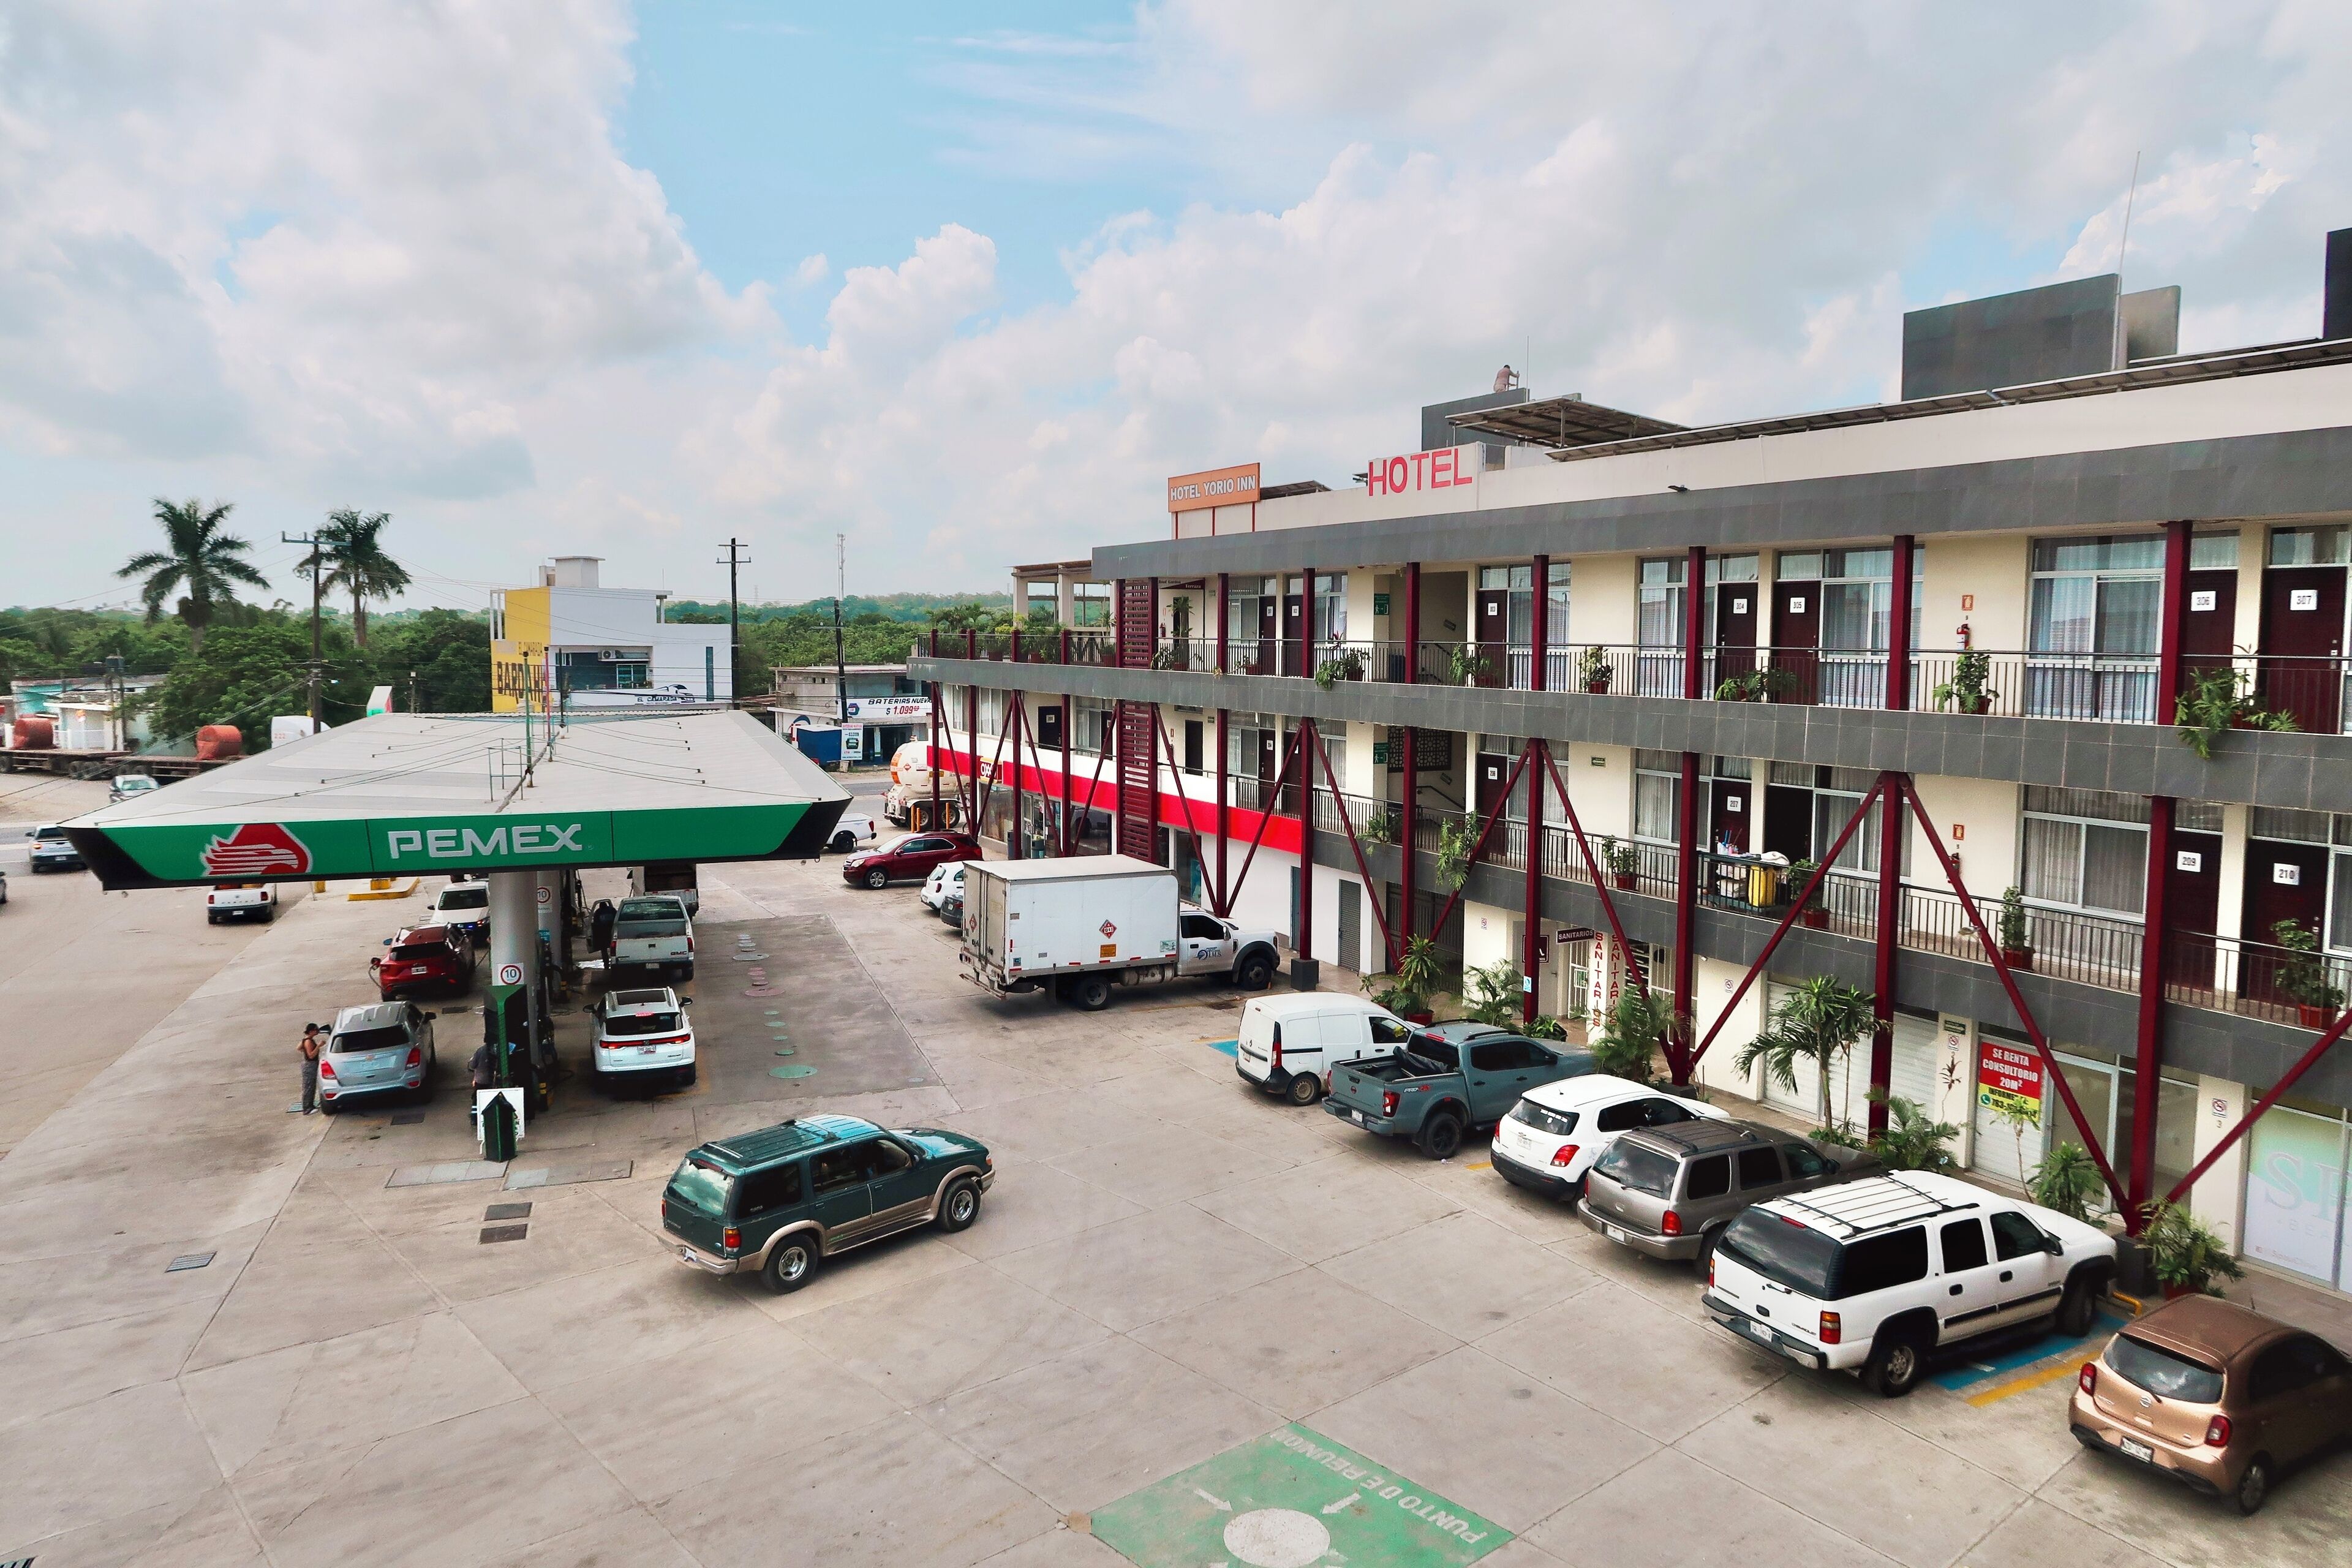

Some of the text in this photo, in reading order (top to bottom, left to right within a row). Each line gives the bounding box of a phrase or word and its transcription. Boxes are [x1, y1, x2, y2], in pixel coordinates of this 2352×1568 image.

[1368, 448, 1472, 497] HOTEL
[1170, 475, 1256, 501] HOTEL YORIO INN
[387, 824, 582, 859] PEMEX
[2278, 869, 2296, 880] 210
[1558, 930, 1593, 940] SANITARIOS
[505, 968, 517, 978] 10
[1593, 932, 1603, 1027] SANITARIOS
[1992, 1048, 2029, 1066] SE RENTA
[1983, 1058, 2038, 1082] CONSULTORIO
[1988, 1087, 2018, 1101] INFORME
[1359, 1476, 1404, 1500] DE
[1398, 1495, 1488, 1544] PUNTO
